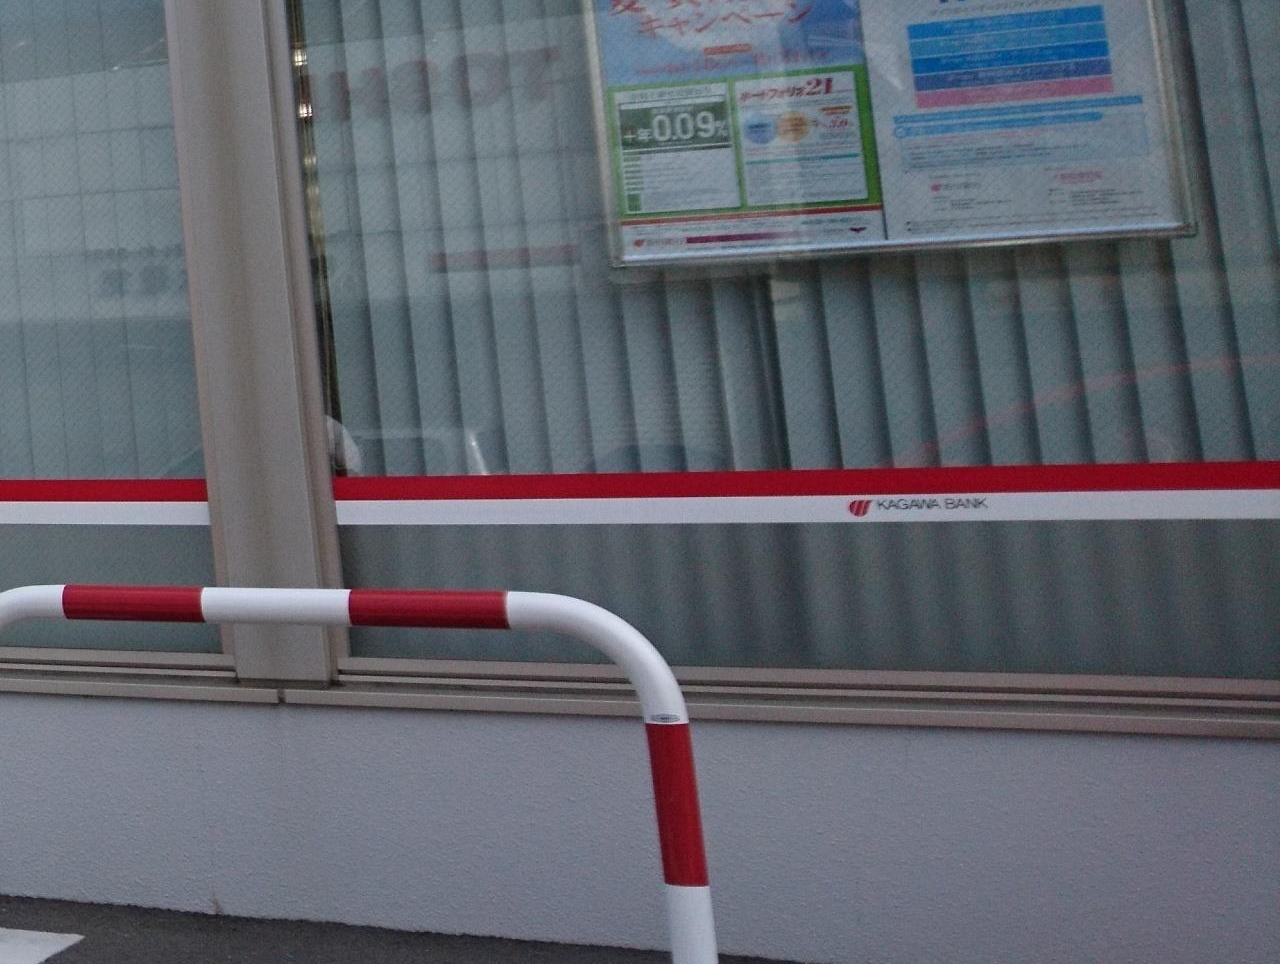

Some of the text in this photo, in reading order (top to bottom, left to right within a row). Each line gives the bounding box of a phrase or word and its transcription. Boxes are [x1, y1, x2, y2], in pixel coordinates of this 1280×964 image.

[639, 3, 812, 38] キャンペーン
[877, 498, 988, 510] KAGAWA BANK
